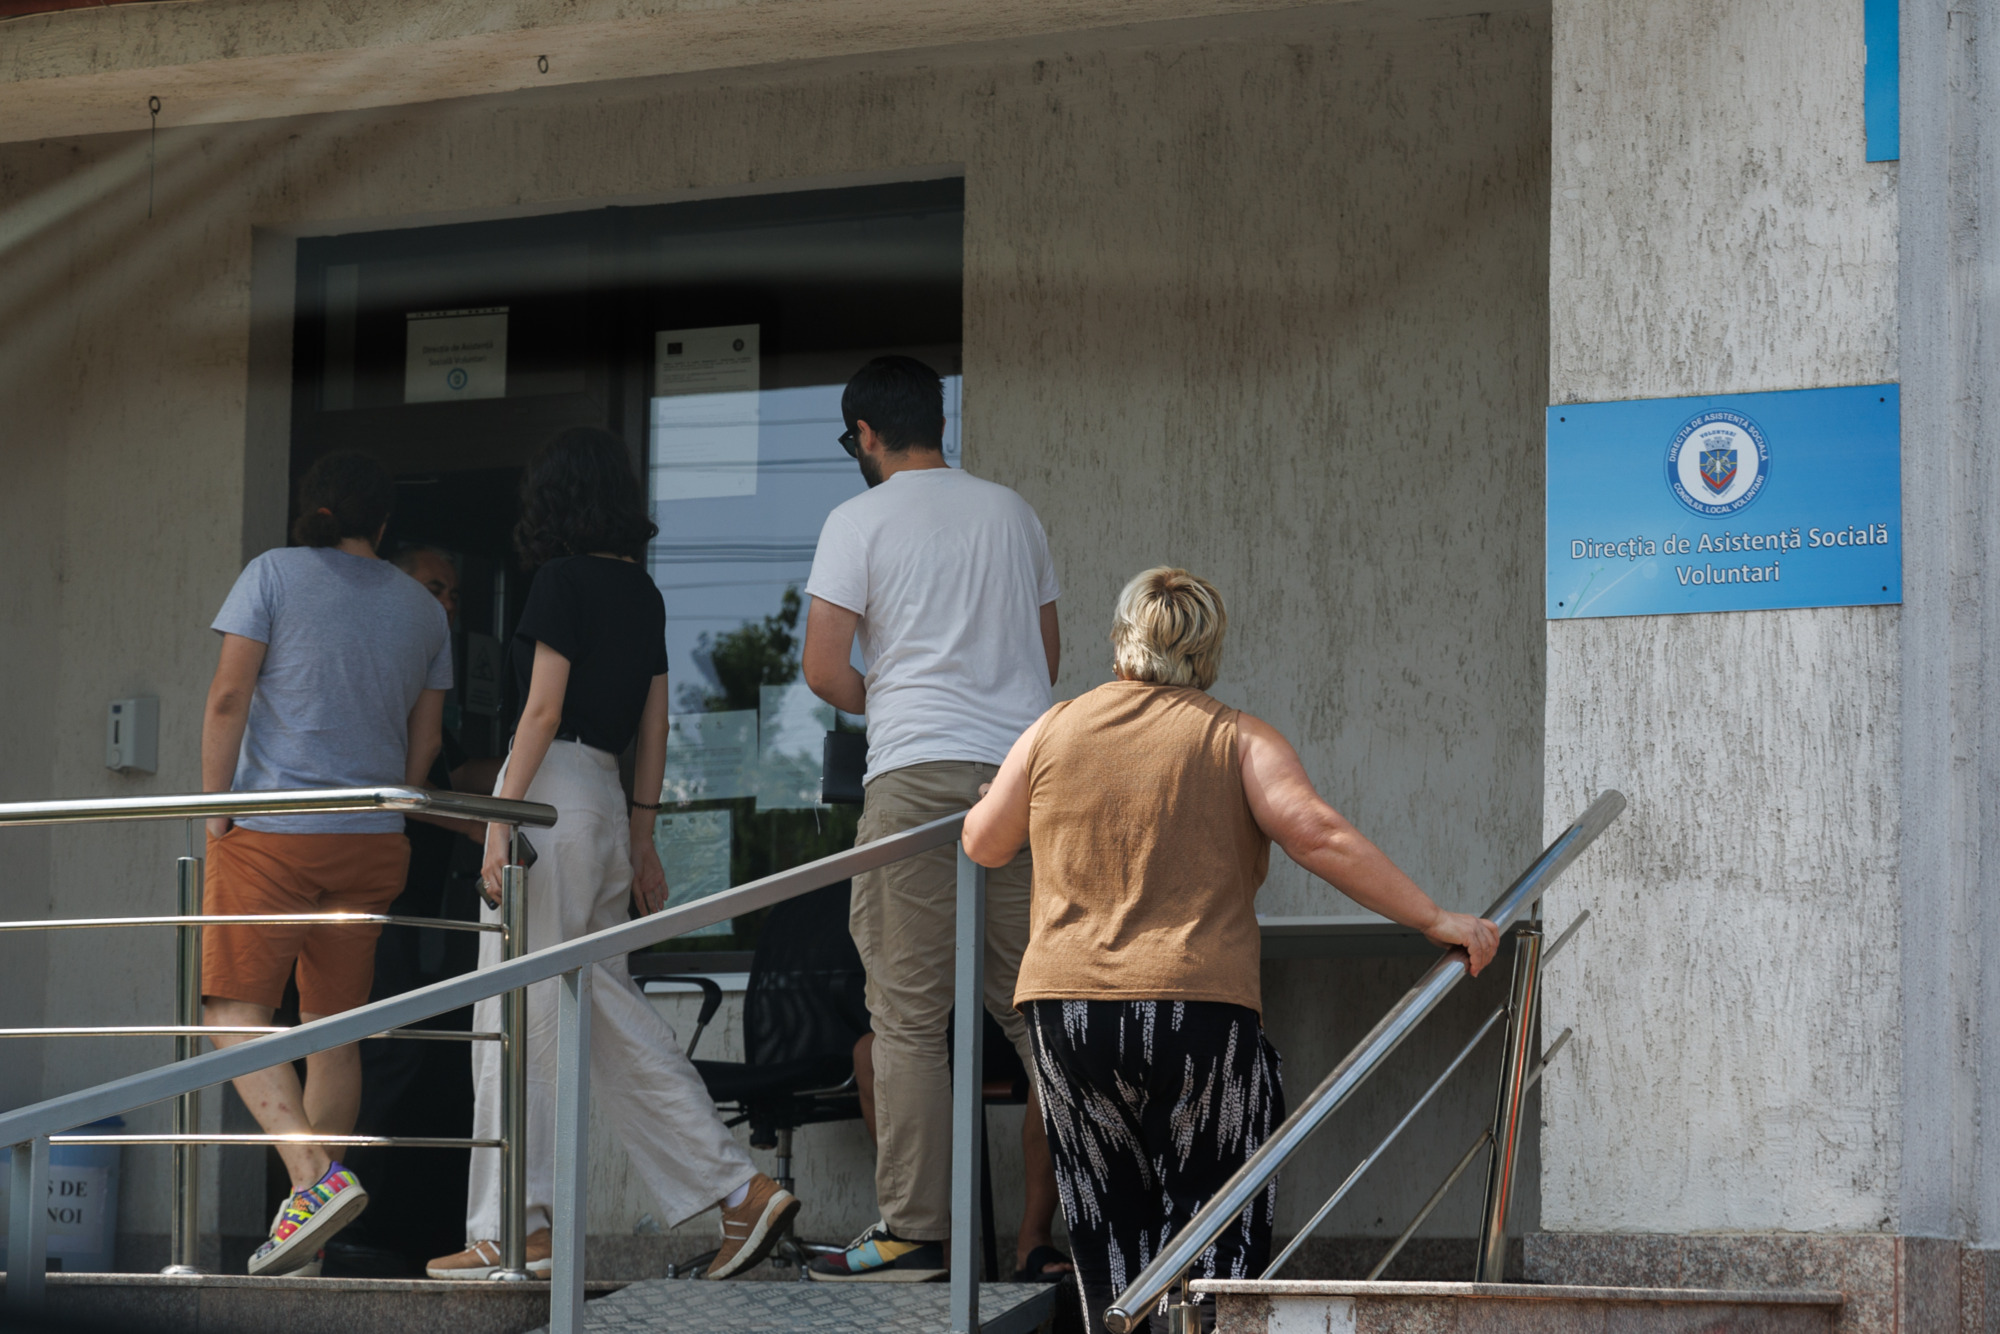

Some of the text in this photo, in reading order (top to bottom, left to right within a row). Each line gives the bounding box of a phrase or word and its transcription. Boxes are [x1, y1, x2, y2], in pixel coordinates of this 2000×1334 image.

[1691, 418, 1703, 428] DE
[1674, 482, 1705, 512] CONSILIUL
[1706, 505, 1732, 514] LOCAL
[1732, 475, 1764, 509] VOLUNTARI
[1570, 523, 1889, 561] Direcția de Asistență Socială
[1676, 561, 1780, 586] Voluntari
[61, 1181, 88, 1197] DE
[48, 1208, 82, 1224] NOI
